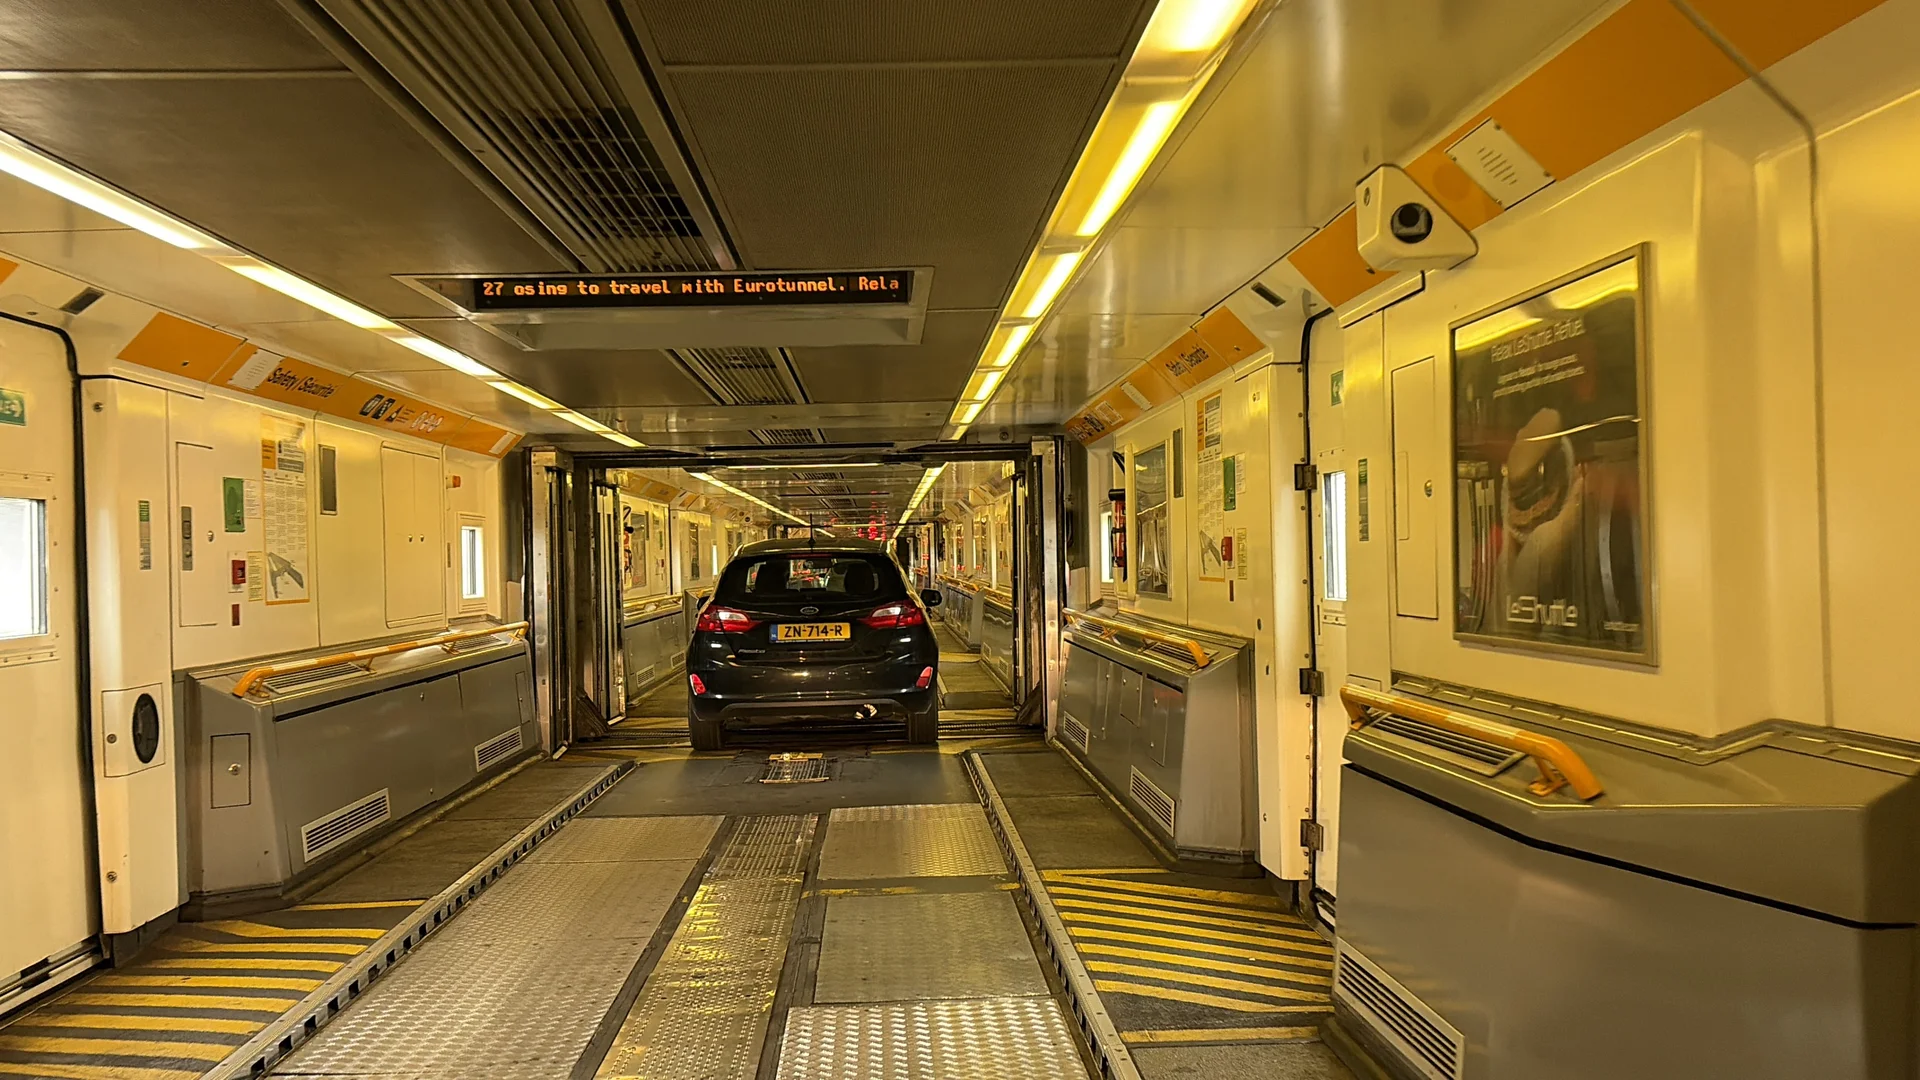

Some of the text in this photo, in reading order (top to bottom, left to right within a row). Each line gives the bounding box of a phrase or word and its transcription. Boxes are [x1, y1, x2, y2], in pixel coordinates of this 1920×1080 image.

[483, 281, 504, 296] 27
[576, 280, 600, 295] to
[609, 279, 671, 295] travel
[681, 279, 725, 293] with
[733, 276, 845, 293] Eurotunnel.
[858, 275, 899, 291] Rela
[1506, 594, 1579, 627] LeShuttle
[784, 624, 843, 638] ZN-714-R
